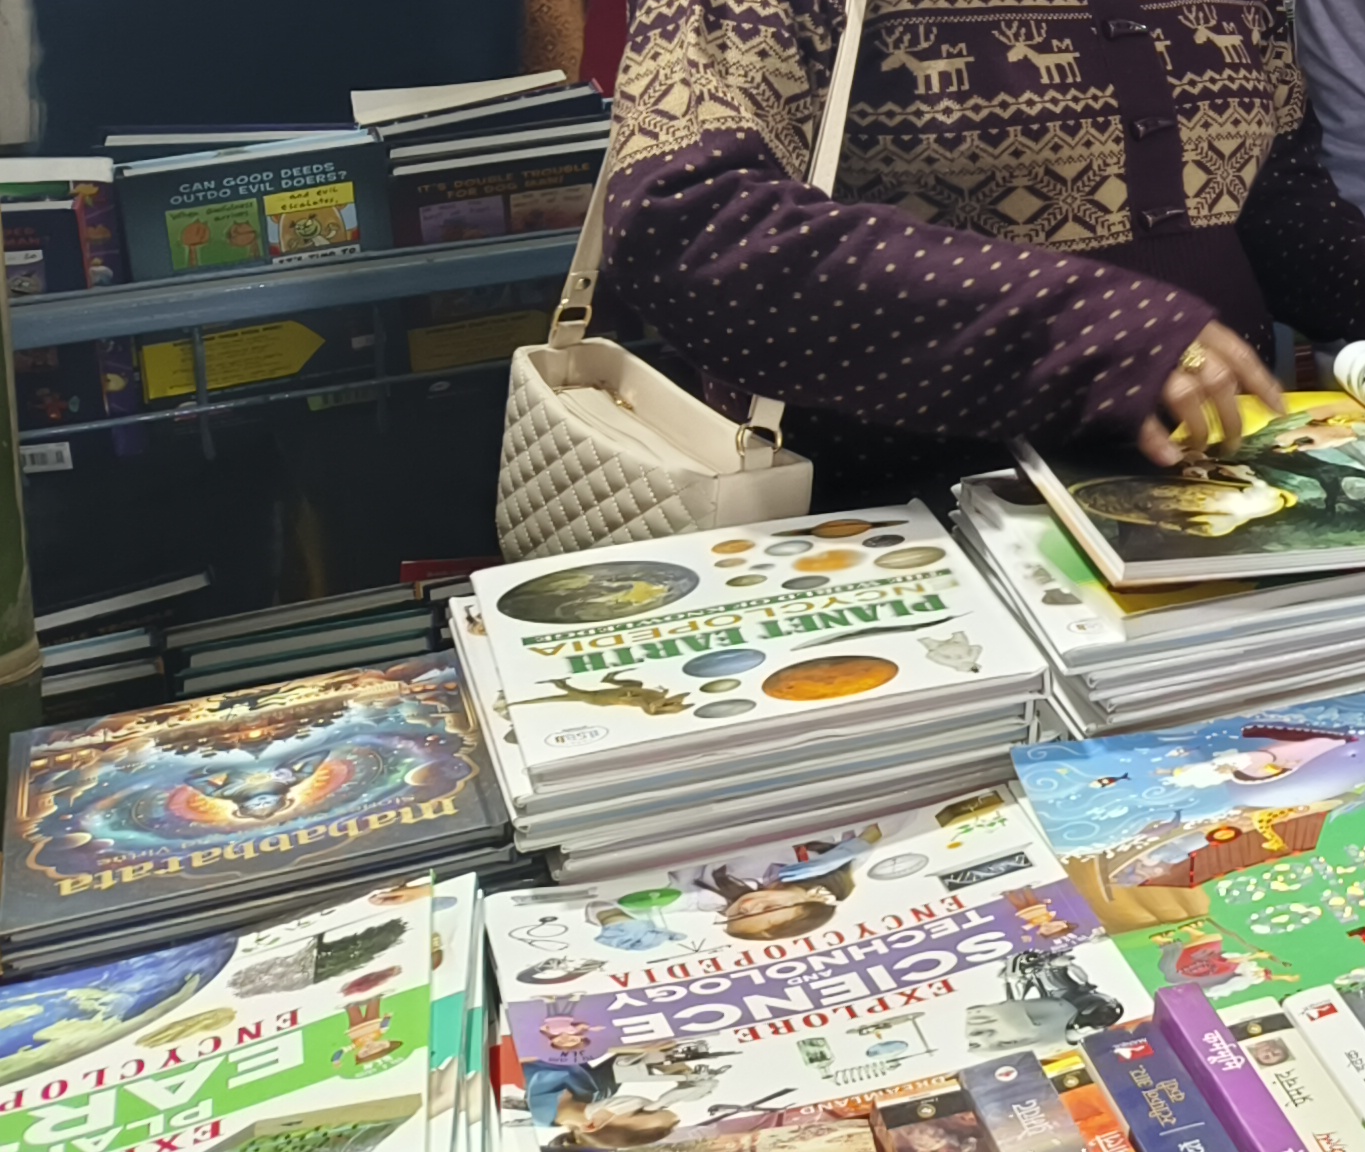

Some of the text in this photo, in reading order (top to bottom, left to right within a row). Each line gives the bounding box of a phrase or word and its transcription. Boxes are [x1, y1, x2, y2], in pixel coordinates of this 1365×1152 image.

[170, 171, 348, 207] OUTDO EVIL DOERS?
[179, 163, 335, 195] CAN GOOD DEEDS
[521, 163, 590, 179] TROUBLE
[528, 579, 960, 658] ENCYCLOPEDIA
[567, 594, 947, 675] PLANET EARTH
[606, 910, 994, 1010] TECHNOLOGY
[608, 895, 965, 989] ENCYCLOPEDIA
[610, 929, 1013, 1044] SCIENCE
[785, 969, 832, 986] AND
[730, 979, 955, 1044] EXPLORE
[1201, 1029, 1247, 1072] कर्मभूमि
[800, 1075, 946, 1115] DREAMLAND
